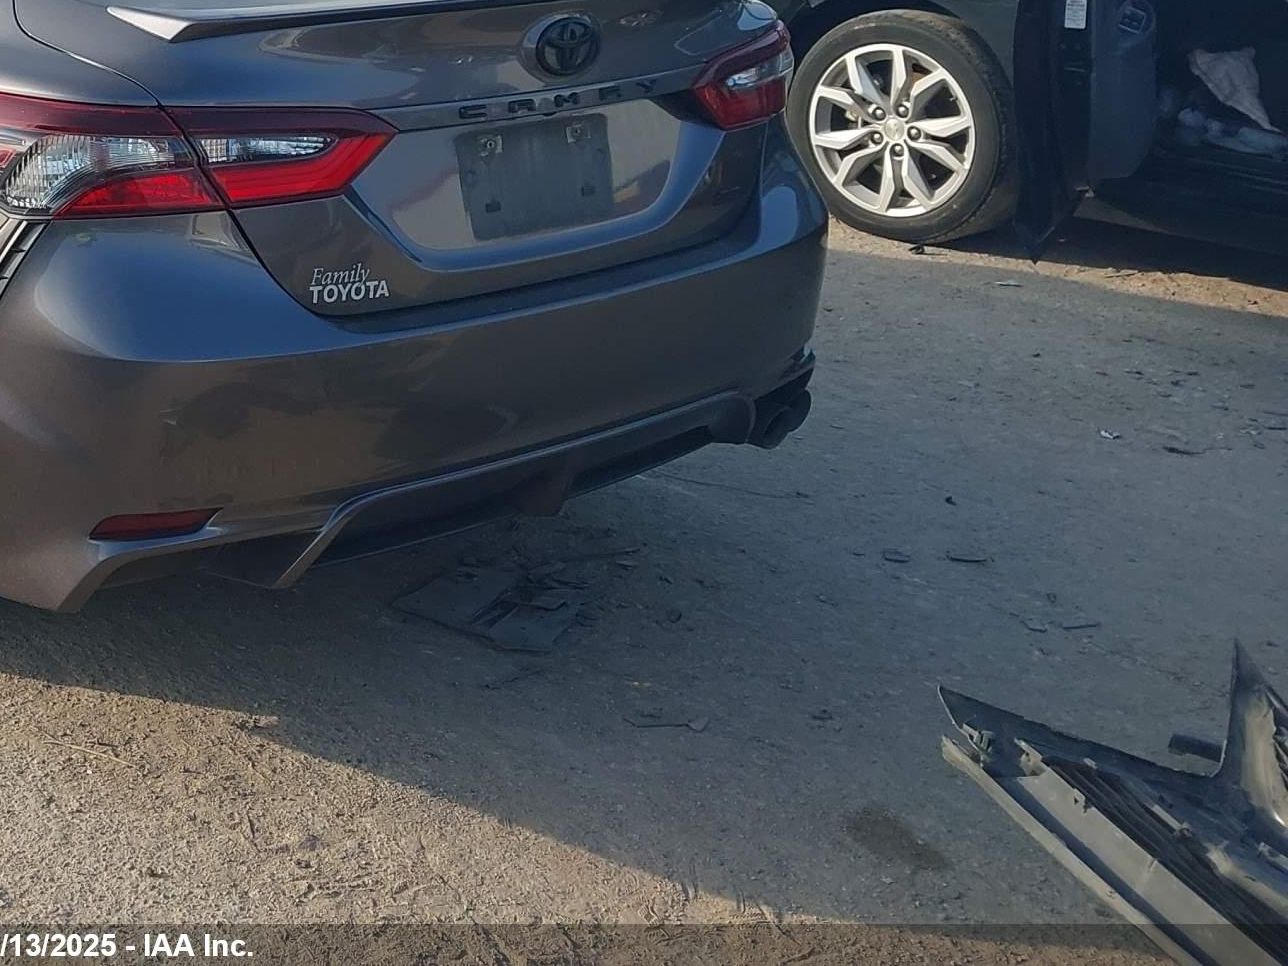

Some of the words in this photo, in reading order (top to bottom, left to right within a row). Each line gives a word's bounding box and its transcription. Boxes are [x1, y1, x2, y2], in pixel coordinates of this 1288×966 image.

[458, 79, 658, 120] CAMRY
[310, 262, 370, 286] Family
[309, 280, 390, 304] TOYOTA
